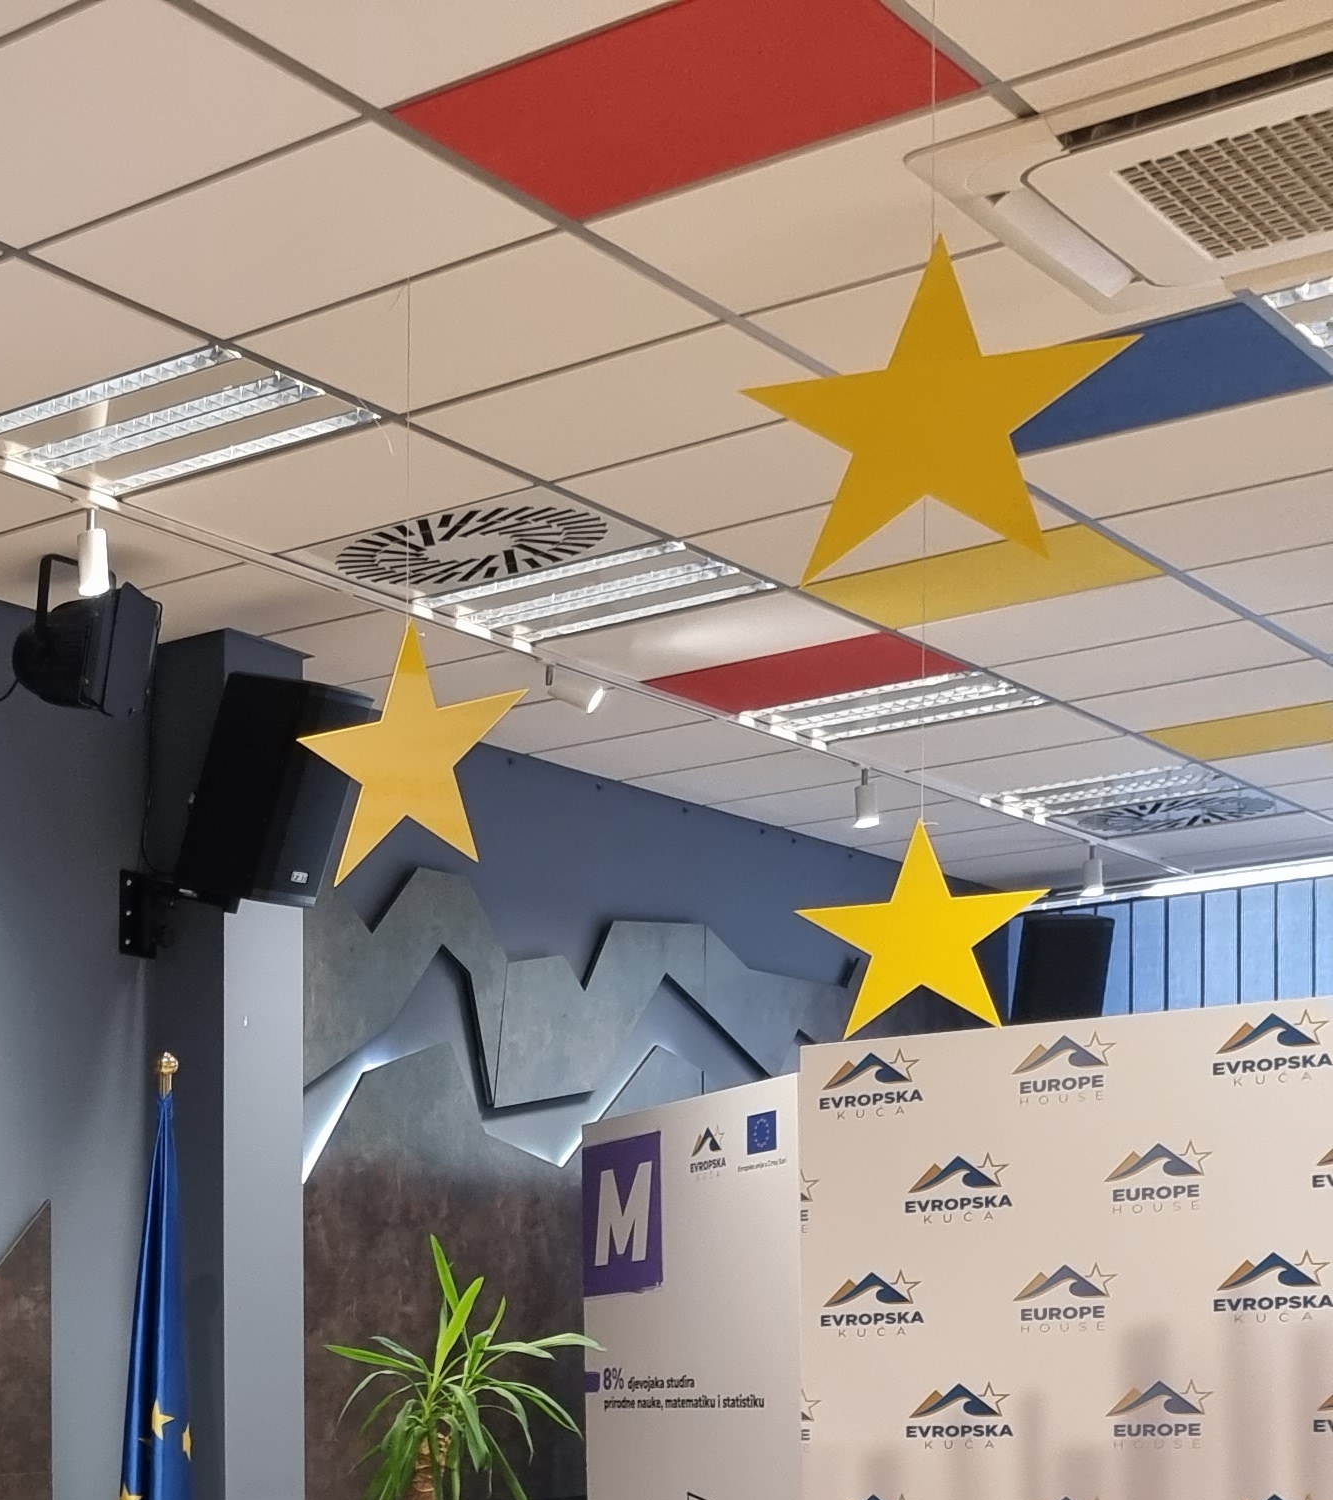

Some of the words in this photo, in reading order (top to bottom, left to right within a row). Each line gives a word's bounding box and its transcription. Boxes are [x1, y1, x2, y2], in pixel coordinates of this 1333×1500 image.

[1213, 1053, 1333, 1075] EVROPSKA
[1020, 1075, 1104, 1094] EUROPE
[820, 1089, 923, 1110] EVROPSKA
[1113, 1184, 1199, 1202] EUROPE
[595, 1161, 652, 1266] M
[905, 1195, 1012, 1213] EVROPSKA
[603, 1368, 624, 1390] 8%
